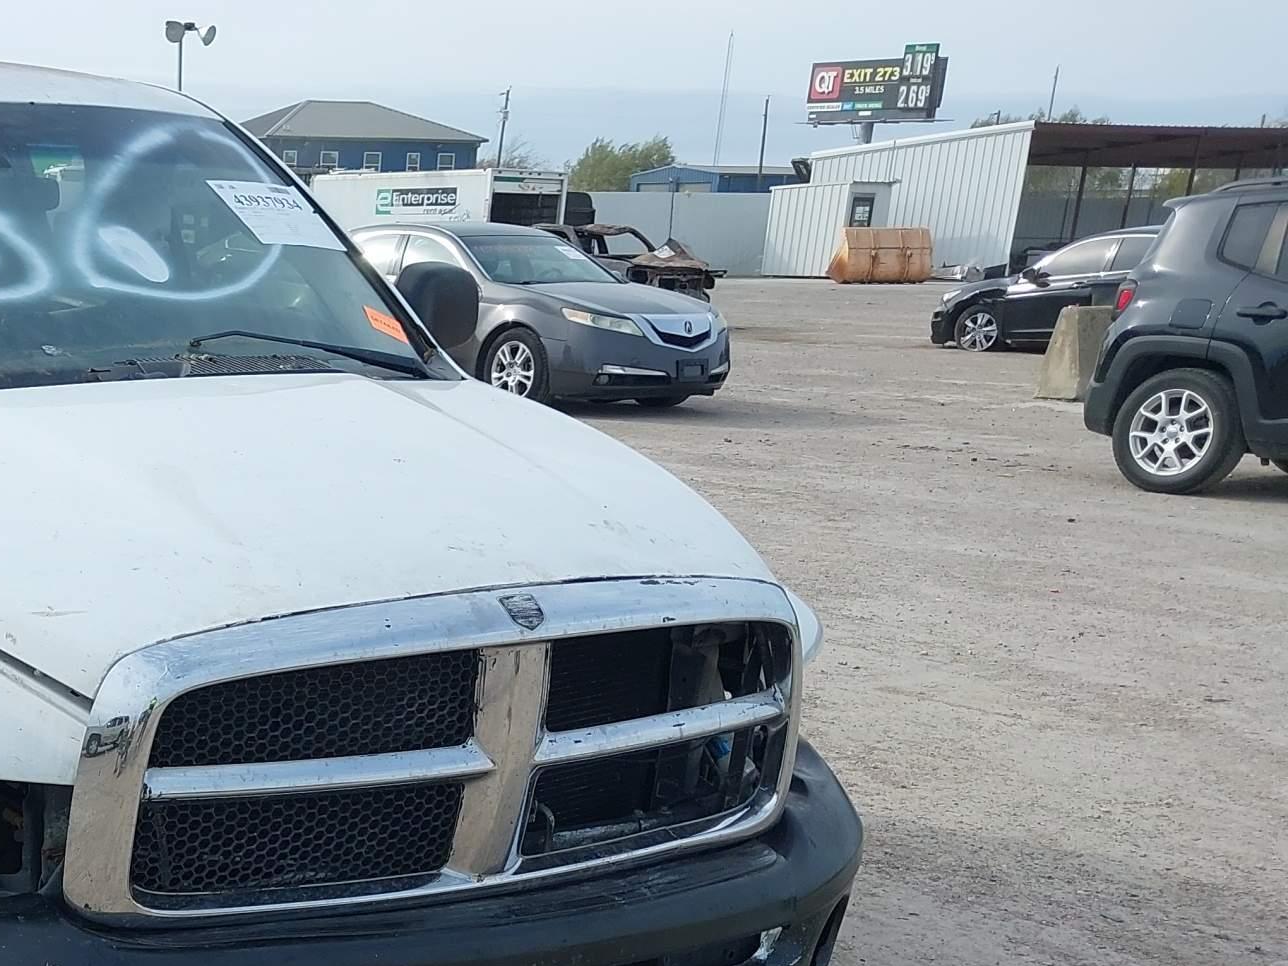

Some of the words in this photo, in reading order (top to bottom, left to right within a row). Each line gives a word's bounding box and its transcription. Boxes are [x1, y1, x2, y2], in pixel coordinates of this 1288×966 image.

[814, 71, 838, 94] QT
[843, 68, 873, 83] EXIT
[875, 66, 900, 82] 273
[865, 85, 885, 94] MILES
[233, 194, 303, 211] 43937934
[392, 189, 456, 206] Enterprise
